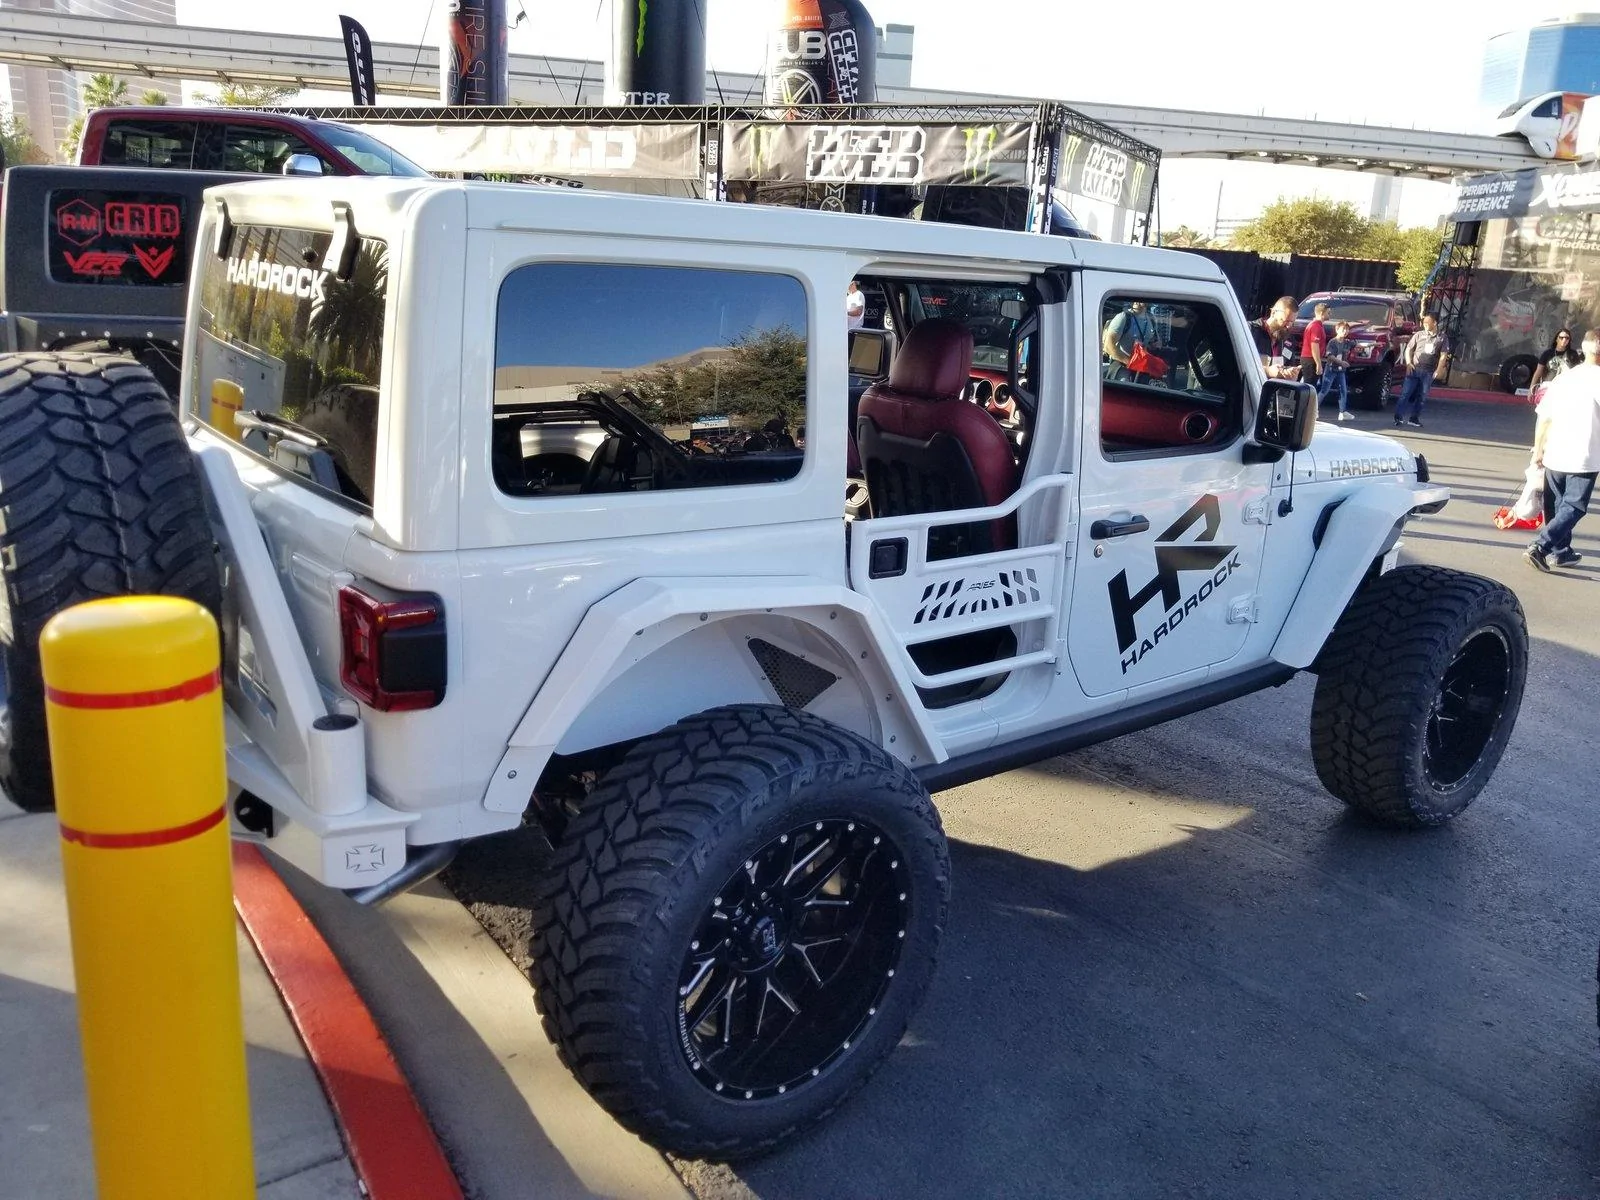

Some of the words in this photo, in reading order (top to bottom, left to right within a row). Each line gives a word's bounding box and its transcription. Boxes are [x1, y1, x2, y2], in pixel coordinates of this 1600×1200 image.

[781, 30, 827, 60] UB
[1500, 180, 1517, 192] THE
[1455, 195, 1510, 213] IFFERENCE
[107, 203, 178, 236] GRID
[226, 256, 330, 300] HARDROCK
[1329, 457, 1405, 478] HARDROCK
[1120, 552, 1242, 676] HARDROCK
